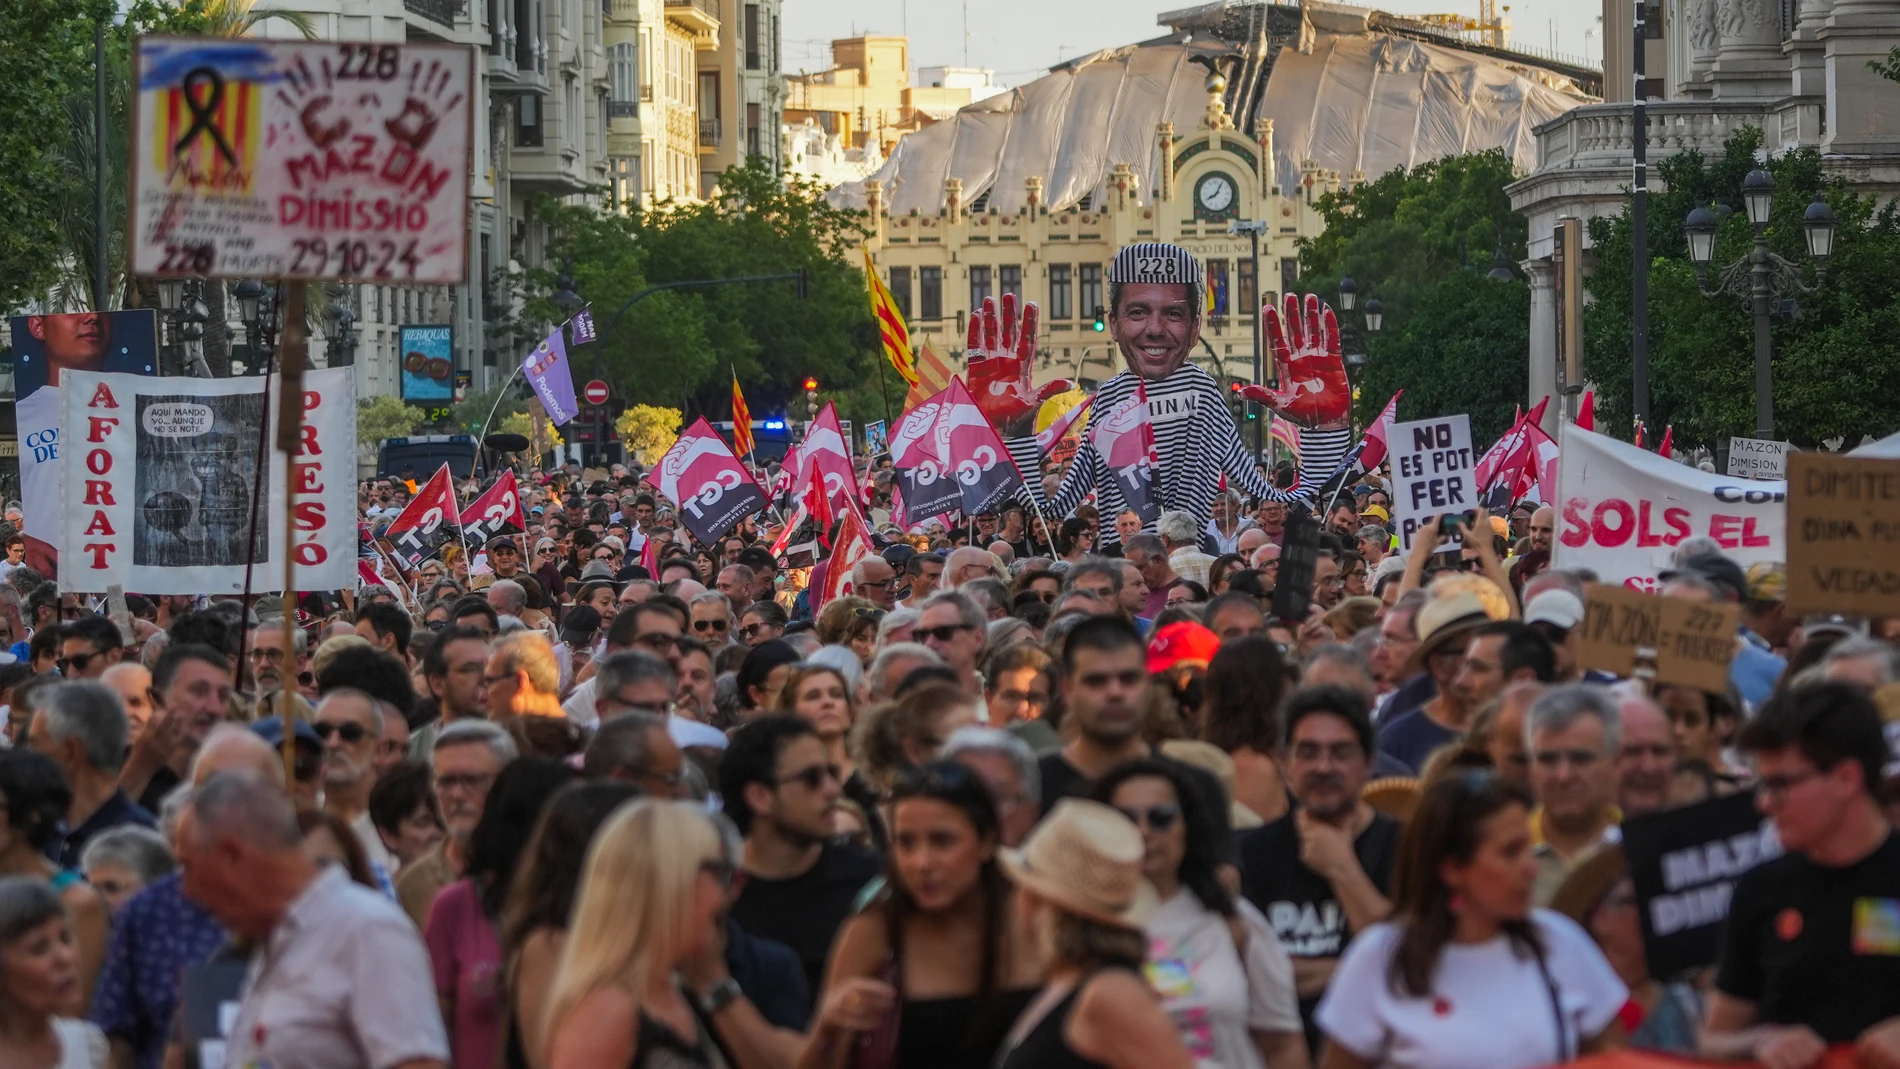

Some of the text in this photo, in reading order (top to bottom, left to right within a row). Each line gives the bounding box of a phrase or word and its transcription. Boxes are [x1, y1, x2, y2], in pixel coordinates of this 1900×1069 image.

[336, 43, 399, 83] 228
[1140, 258, 1175, 275] 228
[151, 407, 206, 417] AQUÍ MANDO
[536, 376, 566, 421] Podemos
[154, 425, 165, 433] NO
[169, 425, 178, 433] SE
[1413, 423, 1452, 452] NO
[1733, 440, 1782, 454] MAZÓN
[83, 382, 119, 569] AFORAT
[1400, 448, 1470, 478] ES POT
[1731, 457, 1778, 470] DIMISIÓN
[1411, 476, 1465, 510] FER
[1560, 497, 1770, 549] SOLS EL
